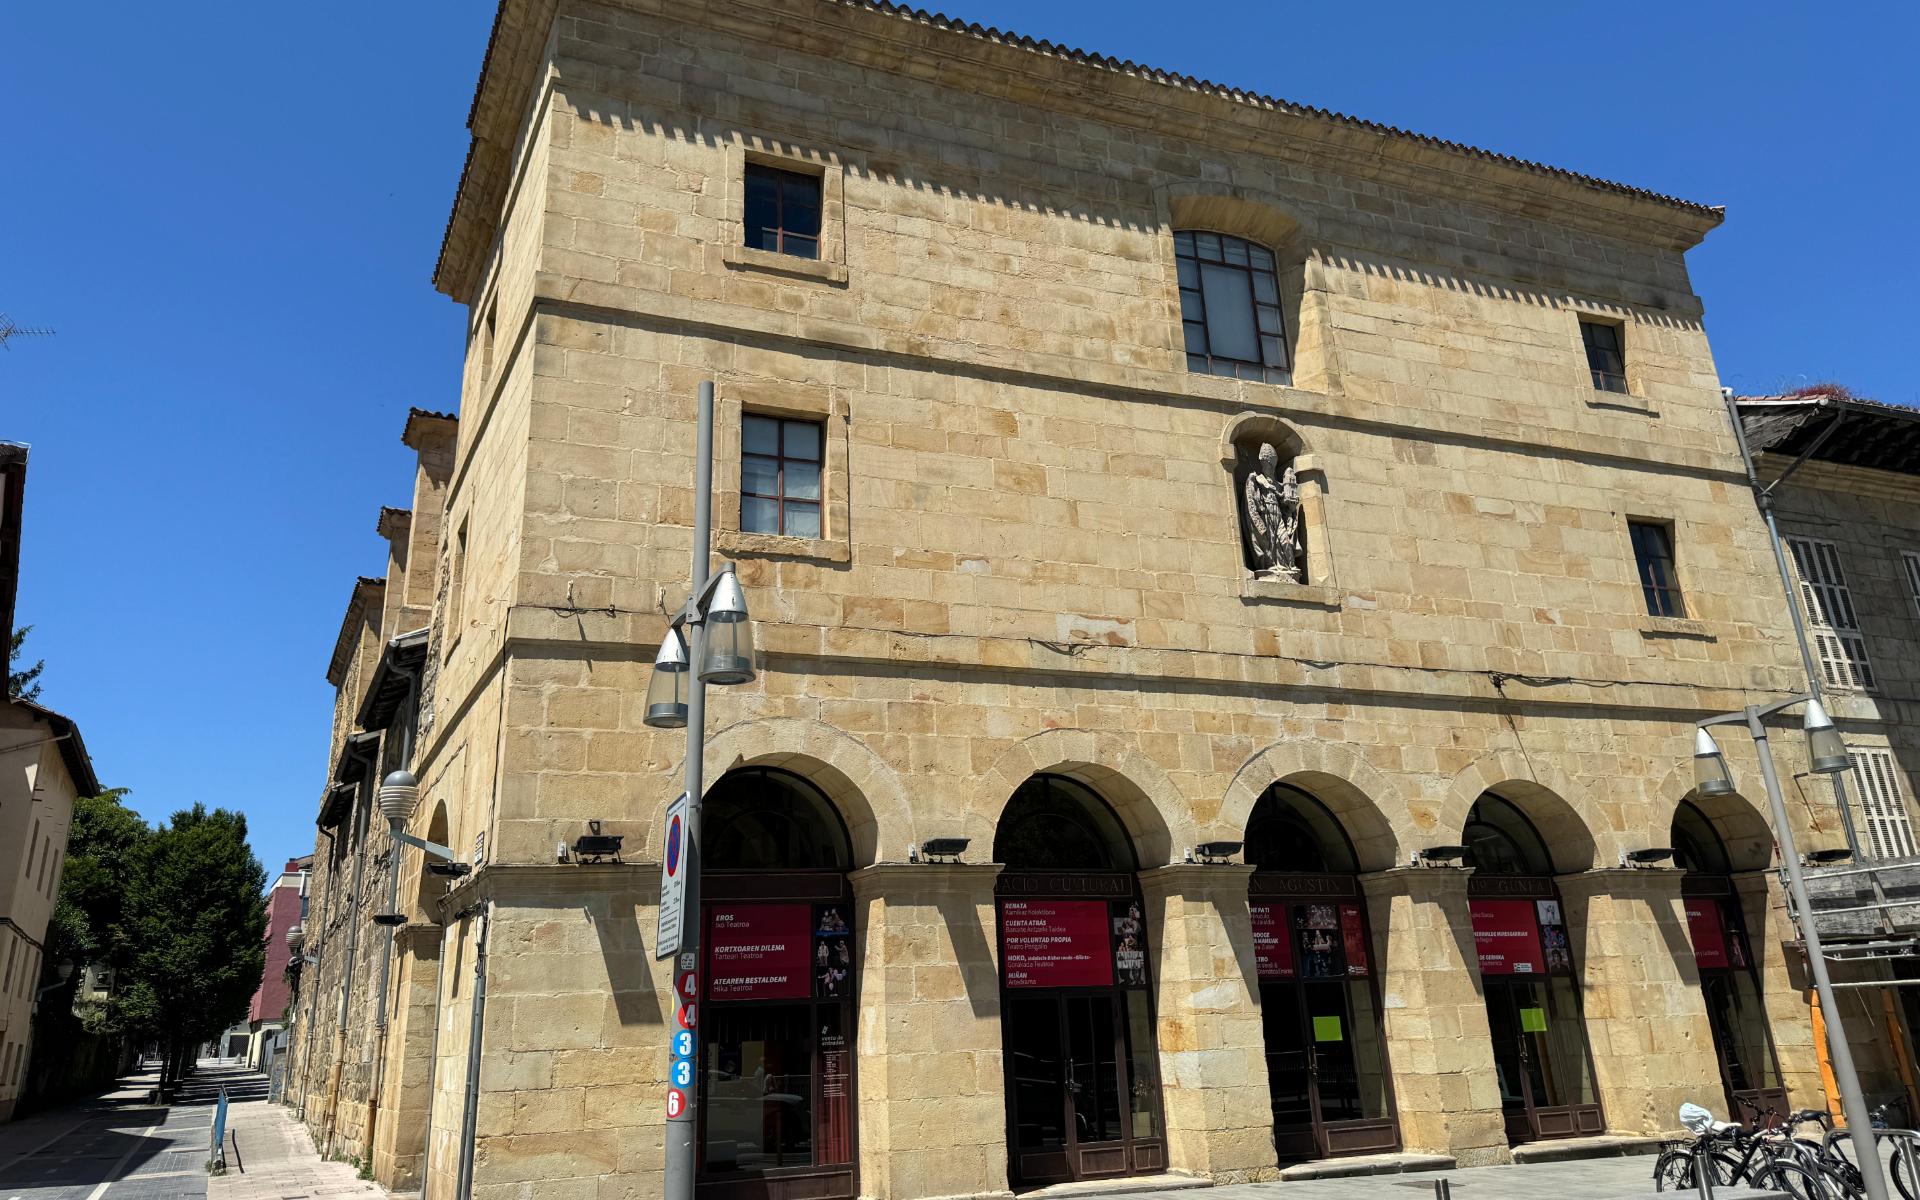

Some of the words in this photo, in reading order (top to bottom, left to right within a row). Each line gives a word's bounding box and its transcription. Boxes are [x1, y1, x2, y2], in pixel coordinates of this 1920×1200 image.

[714, 945, 760, 953] KORTXOAREN
[760, 944, 785, 952] DILEMA
[740, 952, 763, 960] Teatroa
[684, 973, 697, 996] 4
[745, 976, 788, 984] BESTALDEAN
[684, 1004, 697, 1026] 4
[679, 1032, 692, 1056] 3
[677, 1061, 690, 1085] 3
[667, 1091, 679, 1116] 6
